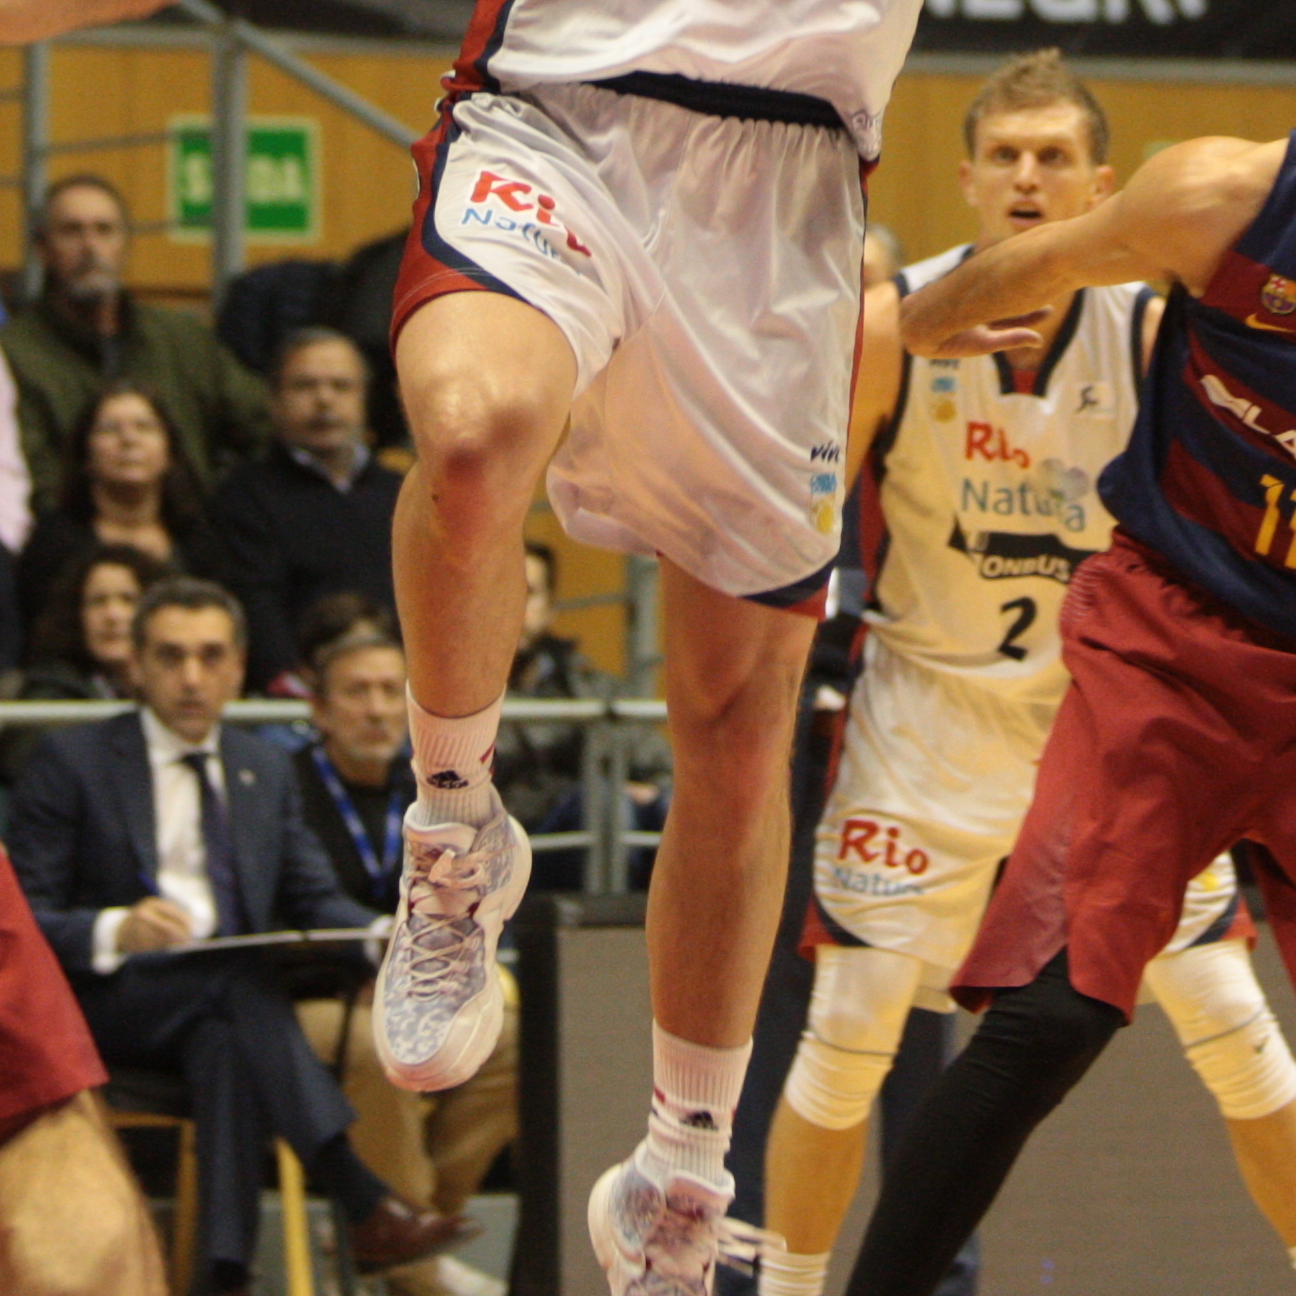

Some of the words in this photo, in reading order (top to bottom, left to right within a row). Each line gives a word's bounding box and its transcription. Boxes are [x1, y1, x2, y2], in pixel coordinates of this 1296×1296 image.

[965, 421, 1031, 471] Rio
[974, 553, 1072, 584] ONBUS
[996, 596, 1038, 662] 2
[837, 817, 931, 876] Rio
